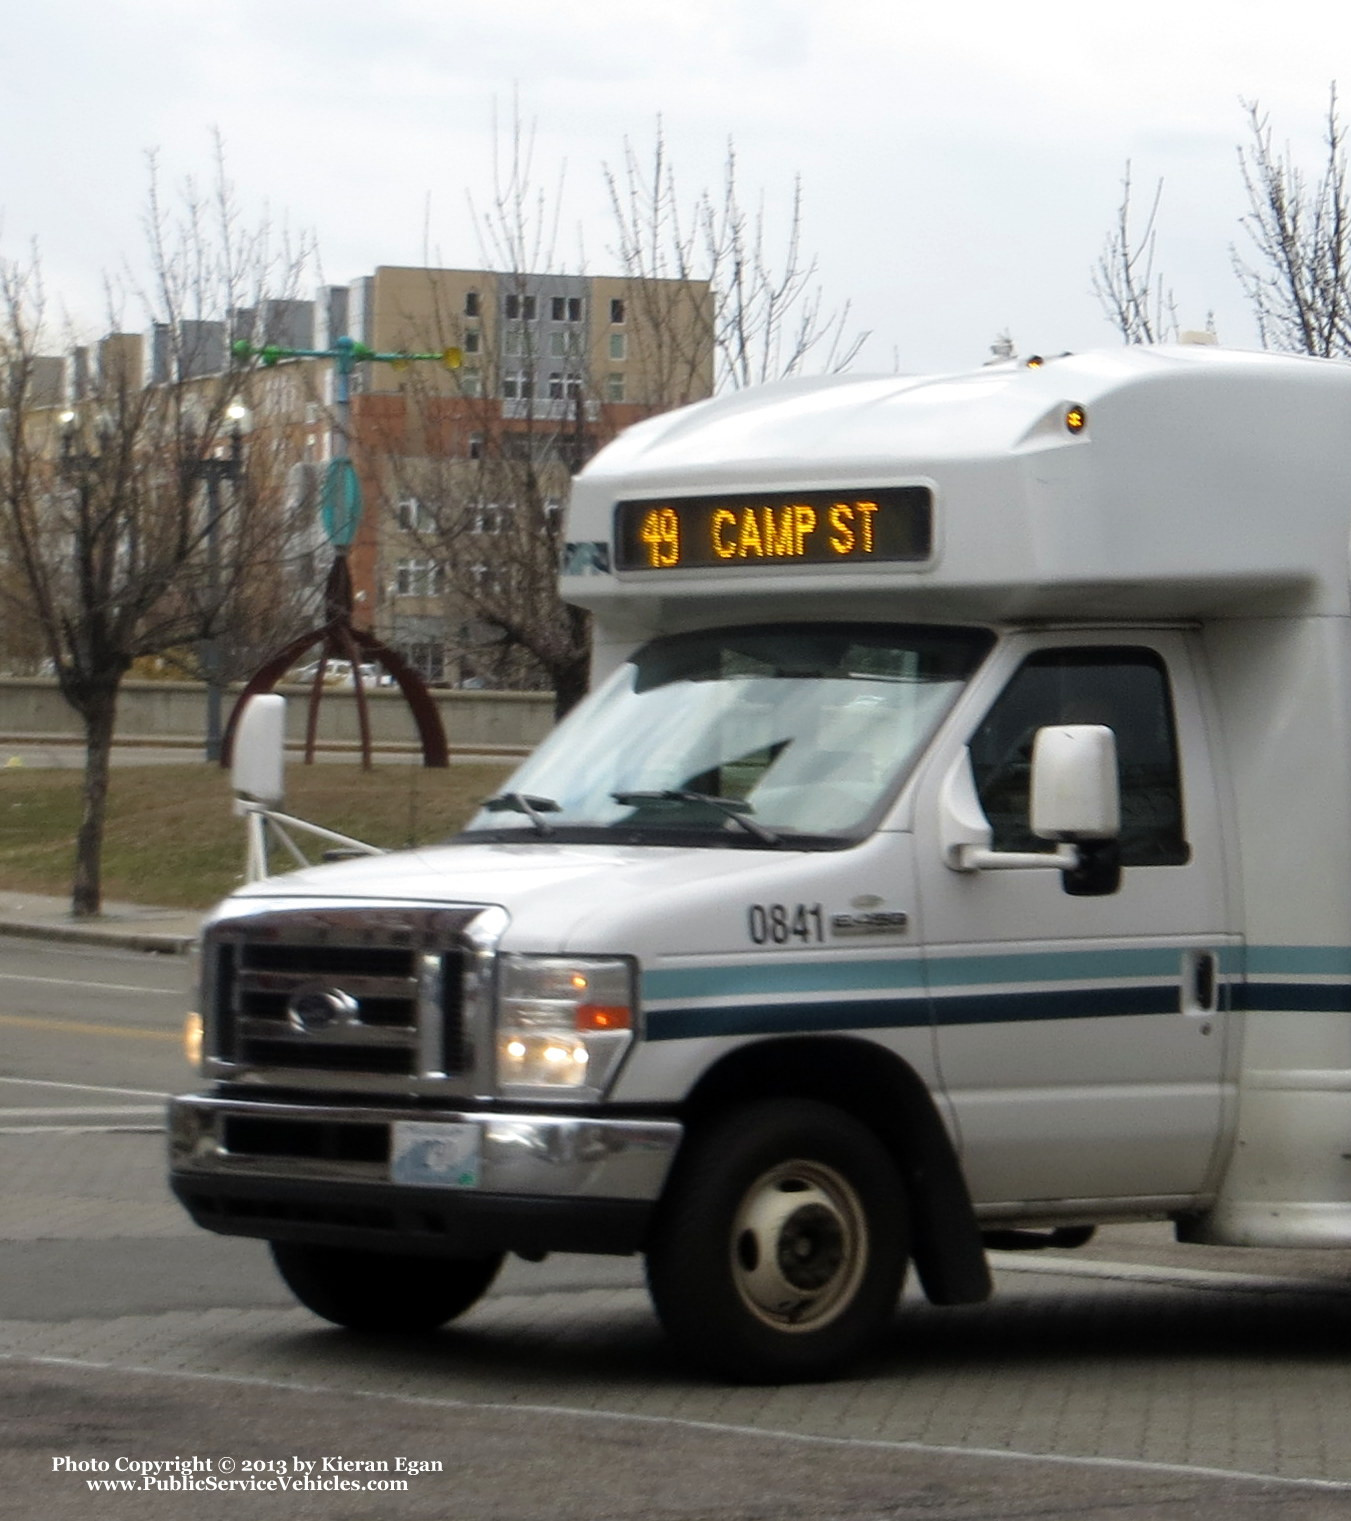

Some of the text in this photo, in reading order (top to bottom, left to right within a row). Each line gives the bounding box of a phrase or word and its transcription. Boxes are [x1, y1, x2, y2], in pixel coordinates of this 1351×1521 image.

[640, 507, 680, 568] 49
[712, 505, 816, 559] CAMP
[828, 502, 877, 554] ST
[750, 903, 823, 944] 0841
